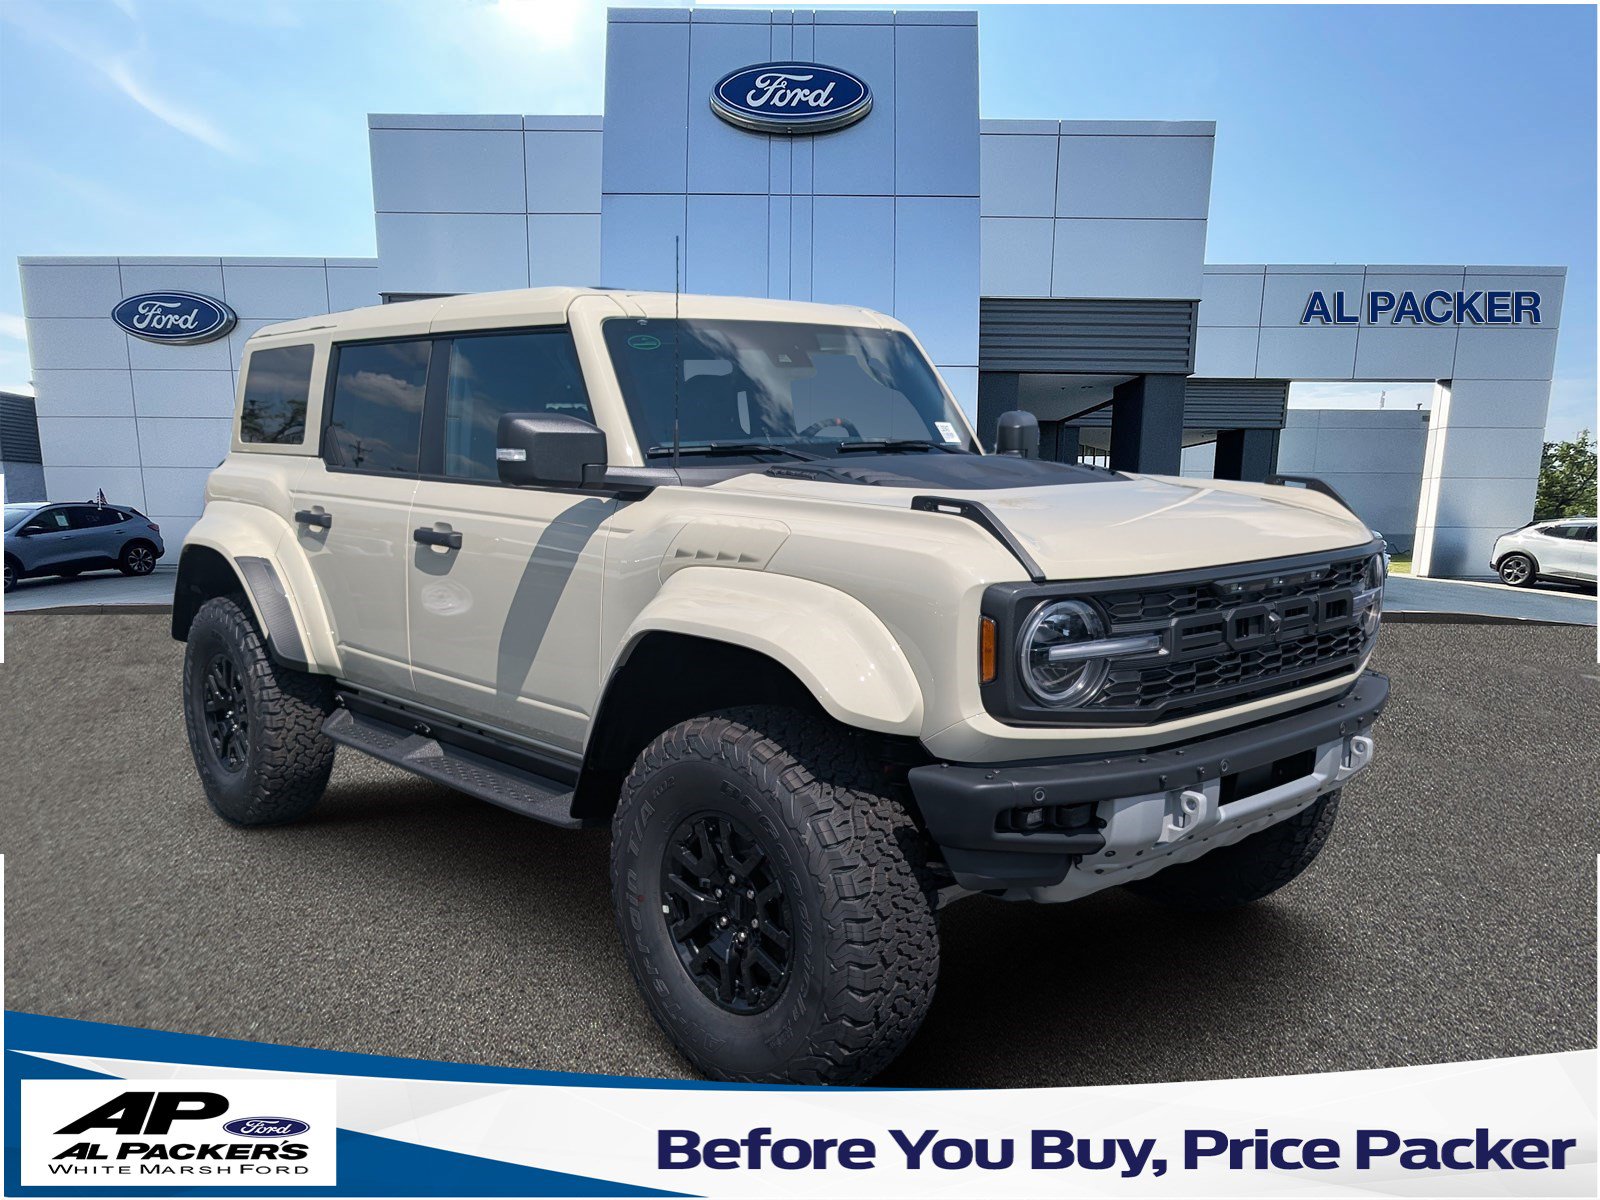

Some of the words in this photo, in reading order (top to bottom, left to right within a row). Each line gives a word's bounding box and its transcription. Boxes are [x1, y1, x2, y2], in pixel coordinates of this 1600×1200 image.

[746, 73, 836, 107] Ford
[133, 301, 199, 329] Ford
[1301, 290, 1360, 324] AL
[1367, 290, 1542, 324] PACKER
[1169, 588, 1354, 662] FORD
